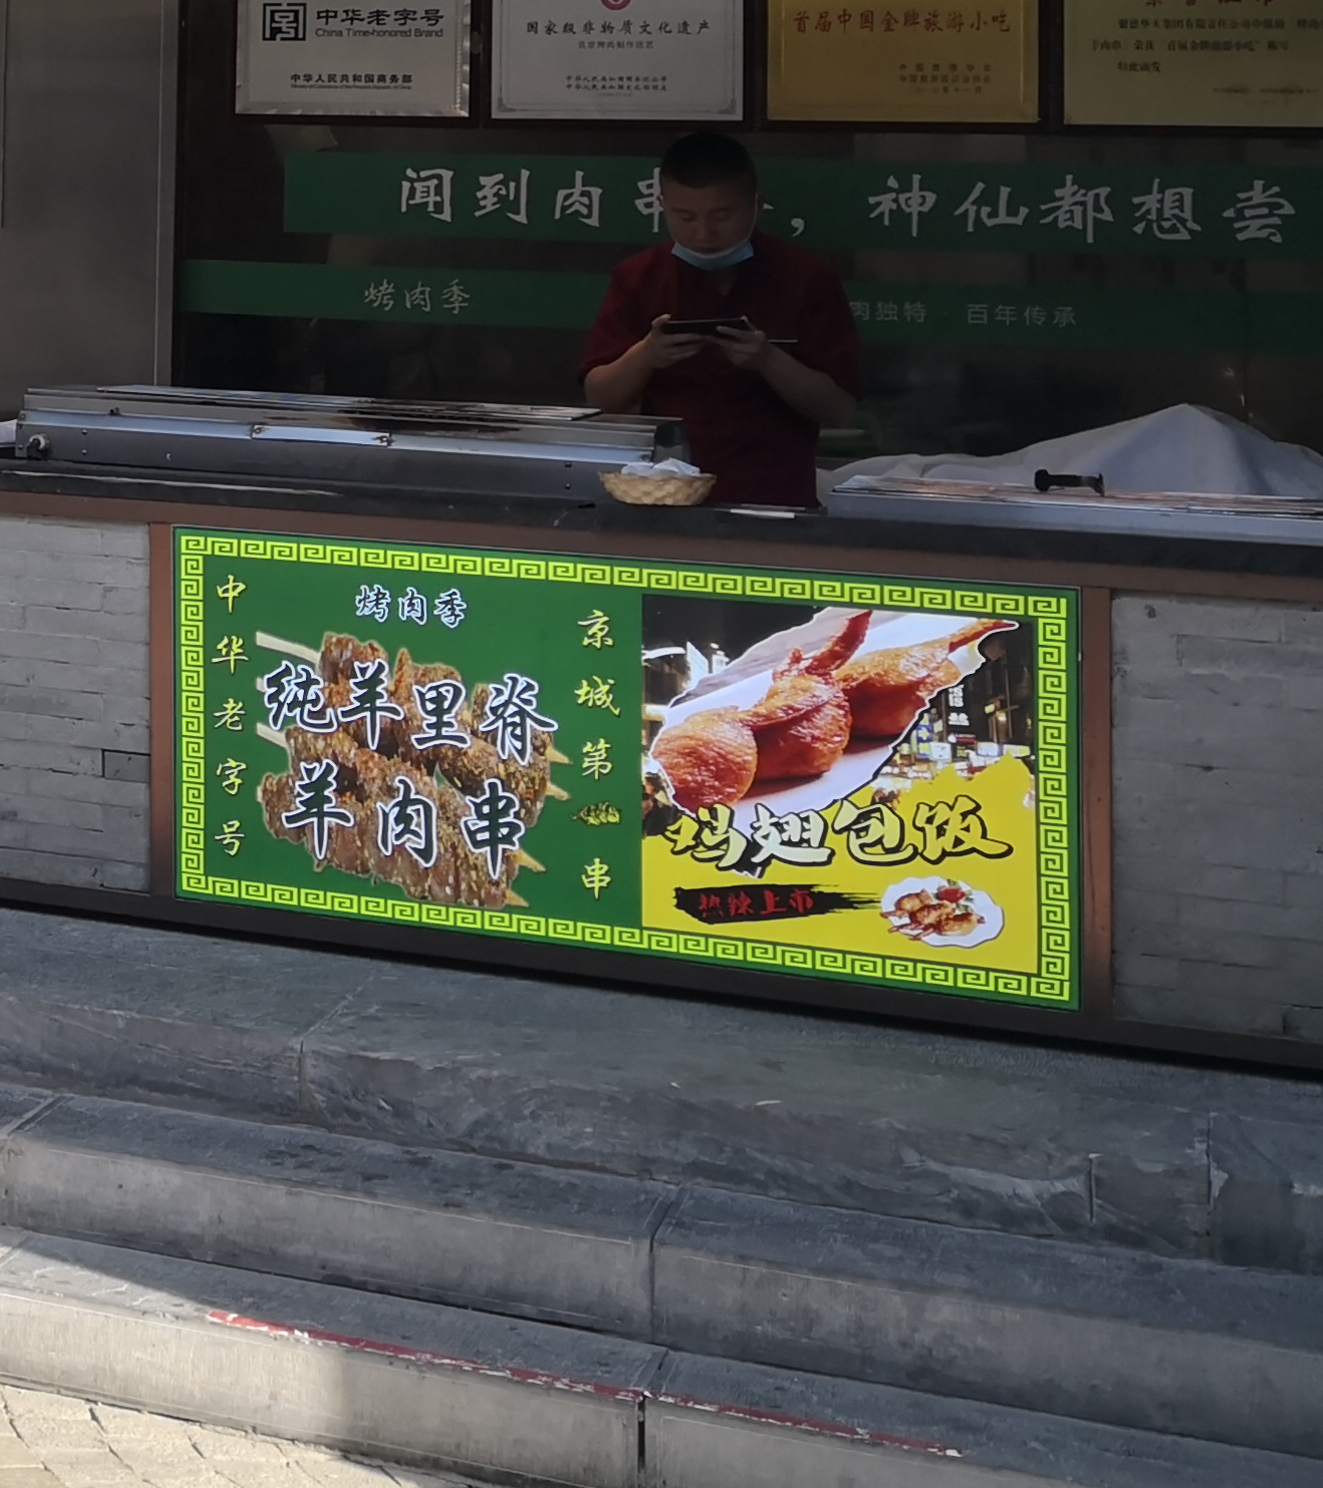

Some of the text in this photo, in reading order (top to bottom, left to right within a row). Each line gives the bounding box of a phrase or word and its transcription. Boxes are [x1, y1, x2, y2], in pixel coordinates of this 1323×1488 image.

[315, 27, 443, 38] China Time-honored Brand
[316, 8, 445, 26] 中华老字号
[526, 19, 710, 36] 国家级非物质文化遗产
[793, 8, 1011, 34] 首届中国金牌旅游小吃
[291, 73, 413, 83] 中华人民共和国商务部
[363, 278, 472, 315] 烤肉季
[355, 584, 468, 629] 烤肉季
[211, 574, 250, 856] 中华老字号
[263, 660, 559, 766] 纯羊里脊
[281, 761, 526, 880] 羊肉串
[664, 794, 1014, 871] 鸡翅包饭
